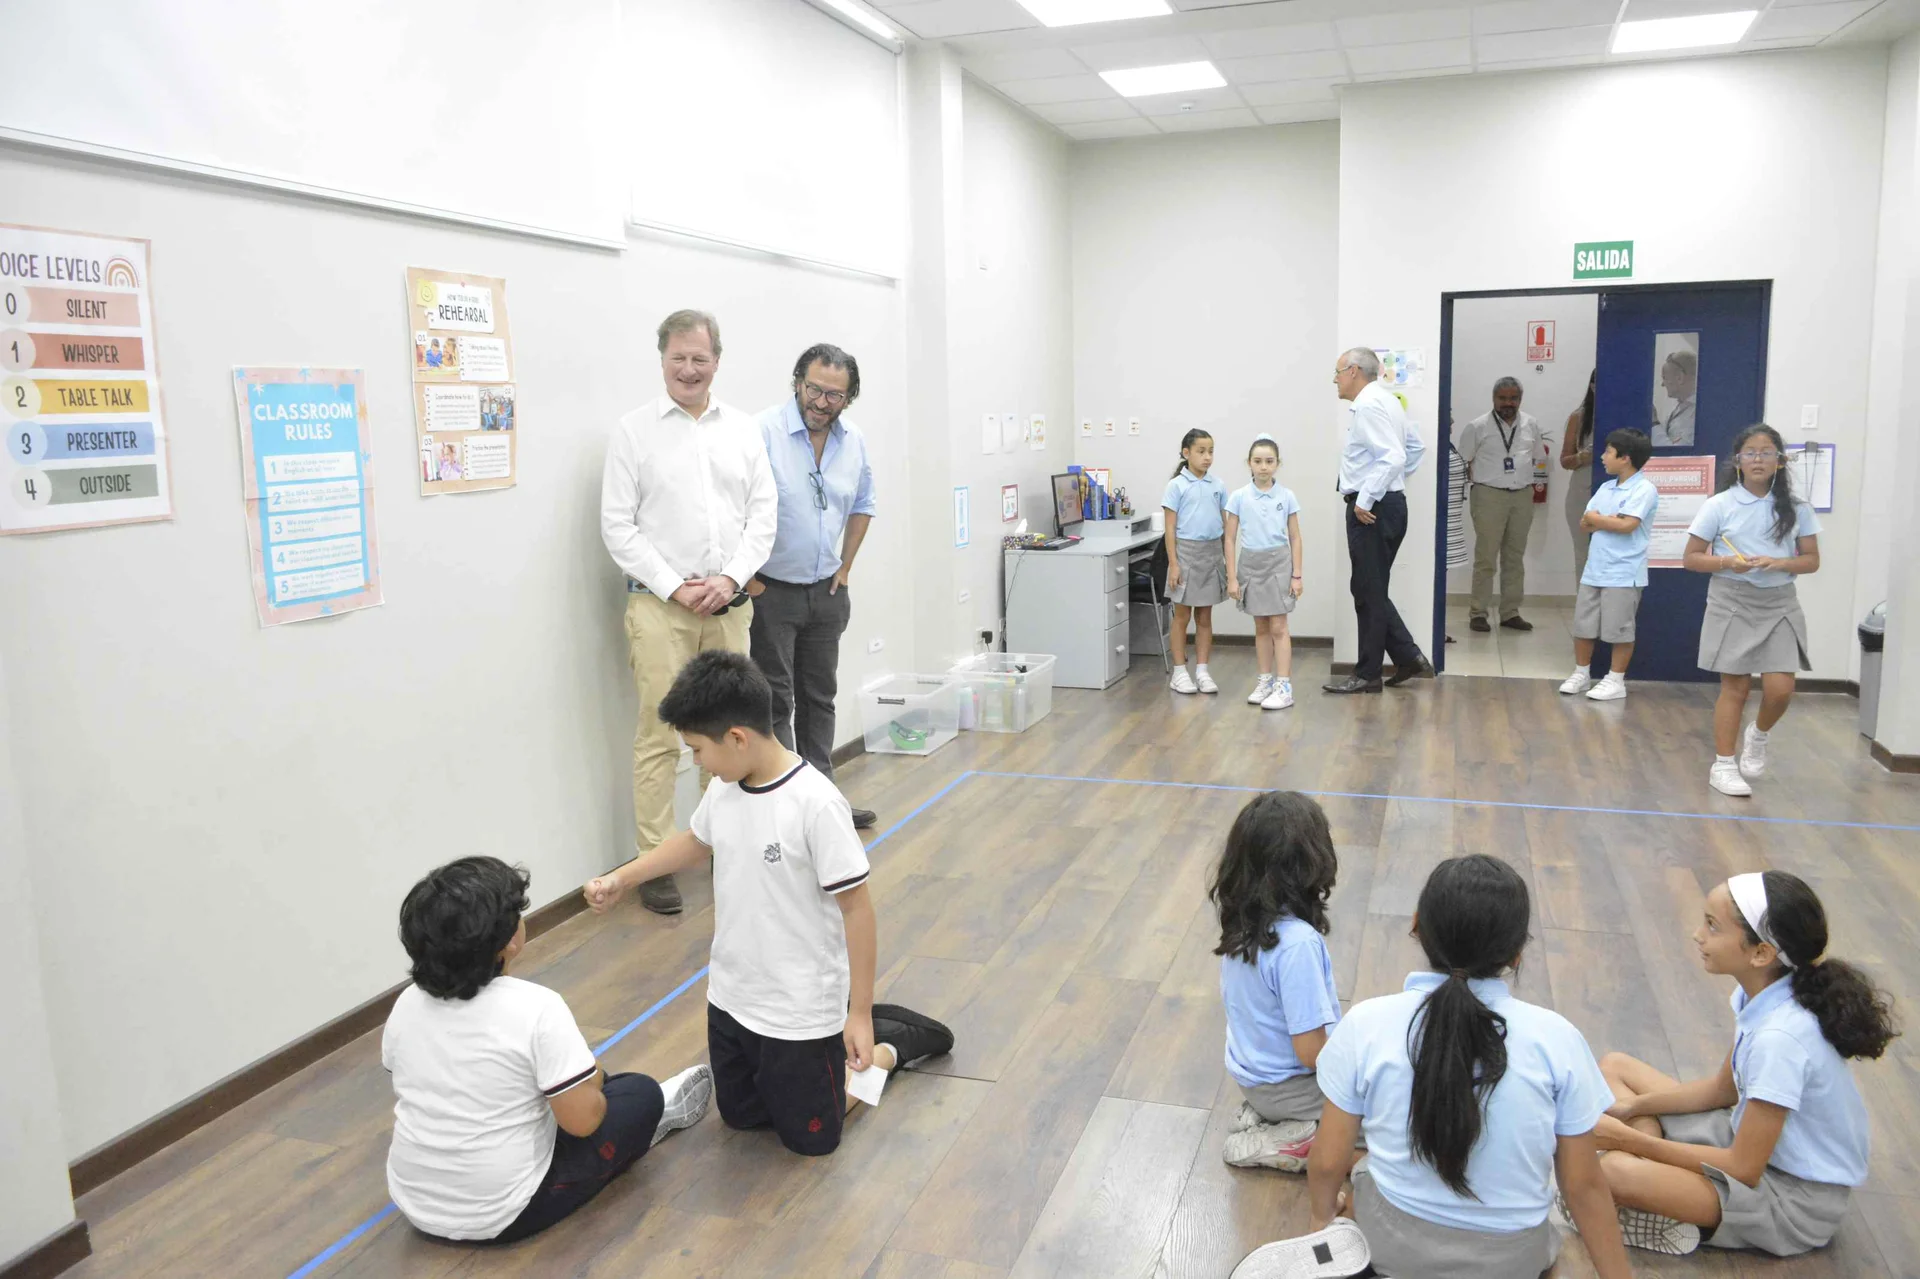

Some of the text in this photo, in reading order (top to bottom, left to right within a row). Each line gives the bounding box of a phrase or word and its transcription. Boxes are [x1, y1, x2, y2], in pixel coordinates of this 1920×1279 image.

[46, 256, 101, 283] LEVELS
[1577, 248, 1630, 271] SALIDA
[5, 292, 107, 320] 0 SILENT
[438, 304, 489, 324] REHEARSAL
[11, 341, 120, 364] 1 WHISPER
[15, 385, 134, 408] 2 TABLE TALK
[254, 402, 353, 421] CLASSROOM
[284, 422, 333, 441] RULES
[21, 430, 137, 455] 3 PRESENTER
[270, 461, 277, 476] 1
[24, 474, 132, 501] 4 OUTSIDE
[272, 491, 282, 506] 2
[274, 521, 283, 535] 3
[276, 550, 286, 565] 4
[281, 579, 289, 594] 5
